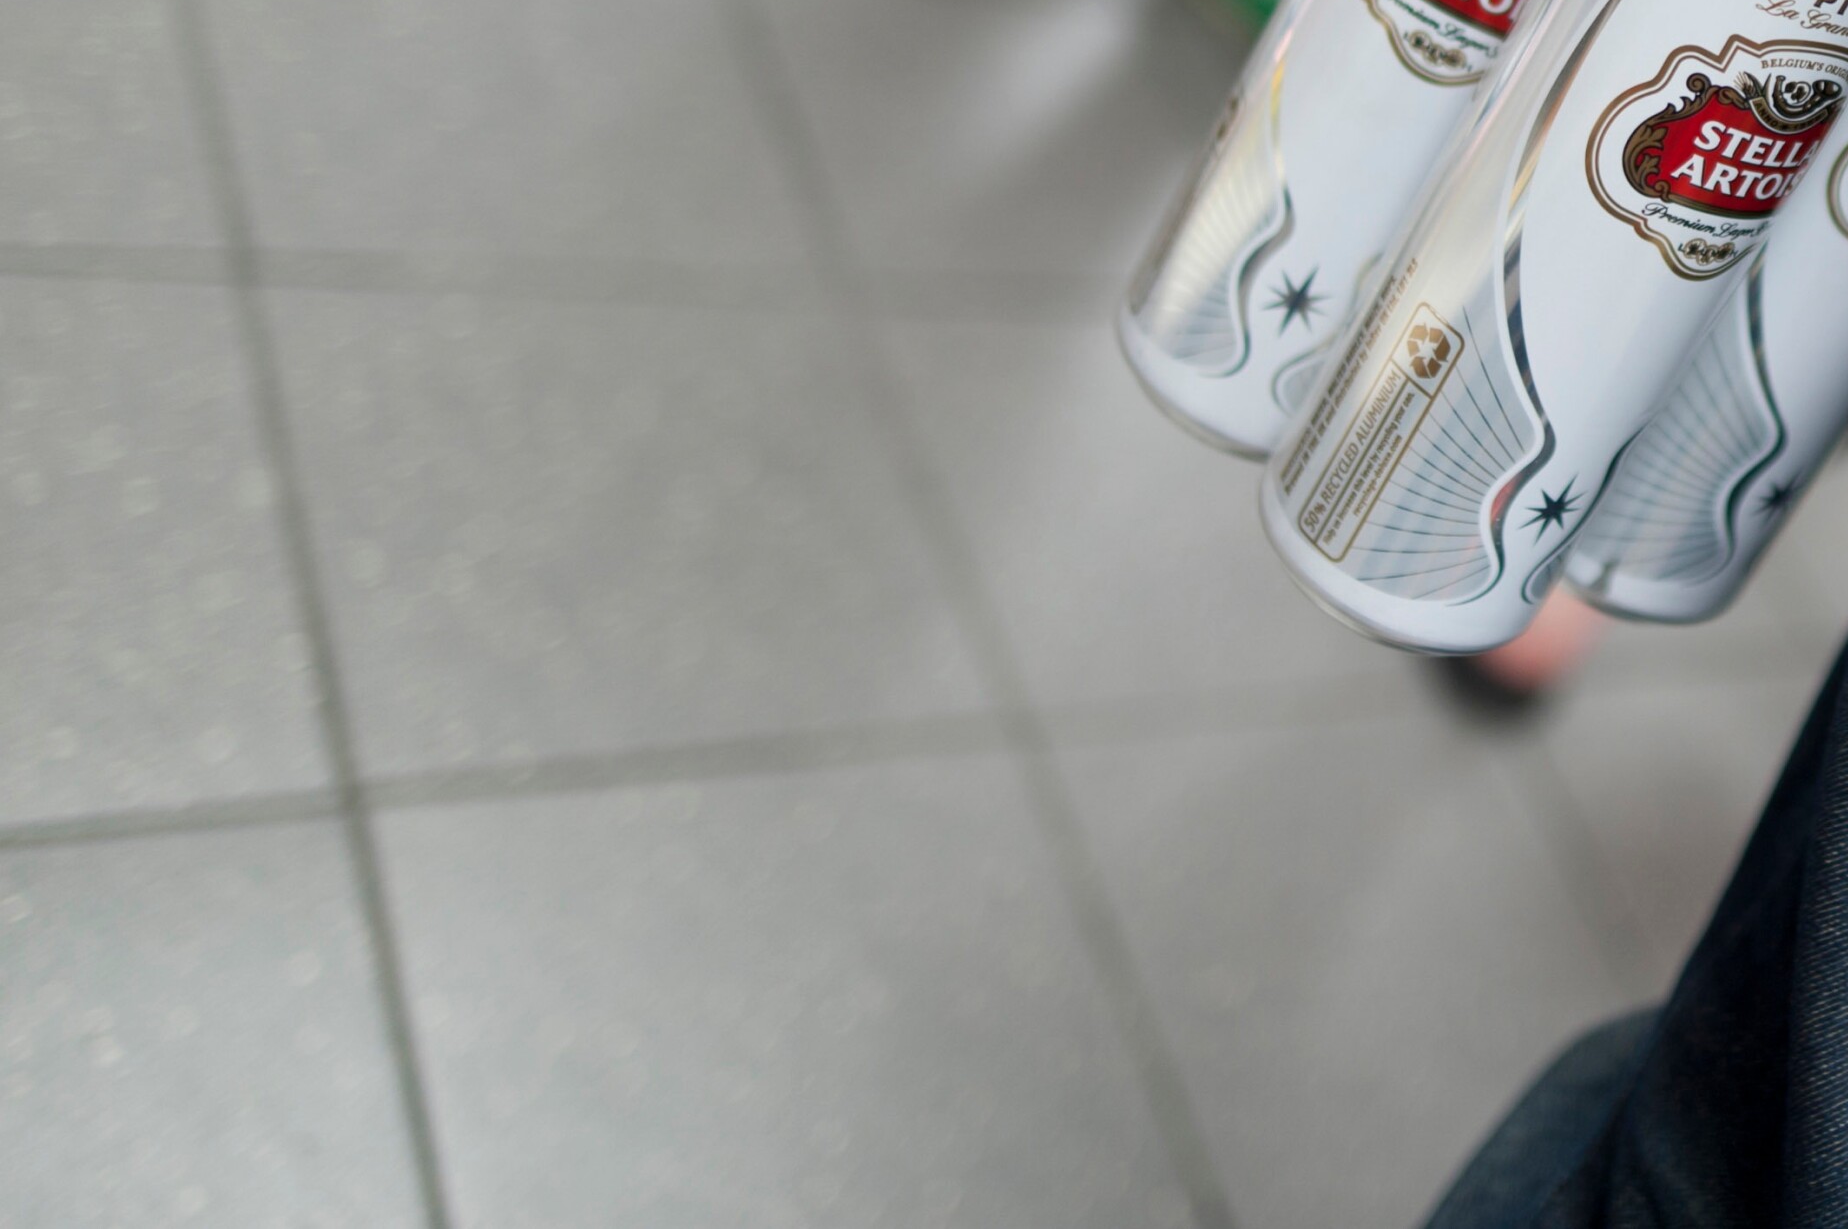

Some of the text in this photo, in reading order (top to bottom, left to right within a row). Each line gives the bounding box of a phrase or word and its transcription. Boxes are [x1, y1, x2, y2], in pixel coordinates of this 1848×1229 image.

[1760, 58, 1825, 72] BELGIUM'S
[1693, 120, 1820, 168] STELLA
[1641, 202, 1717, 234] Premium
[1302, 369, 1399, 533] 50% RECYCLED ALUMINIUM
[1373, 420, 1397, 455] recycling
